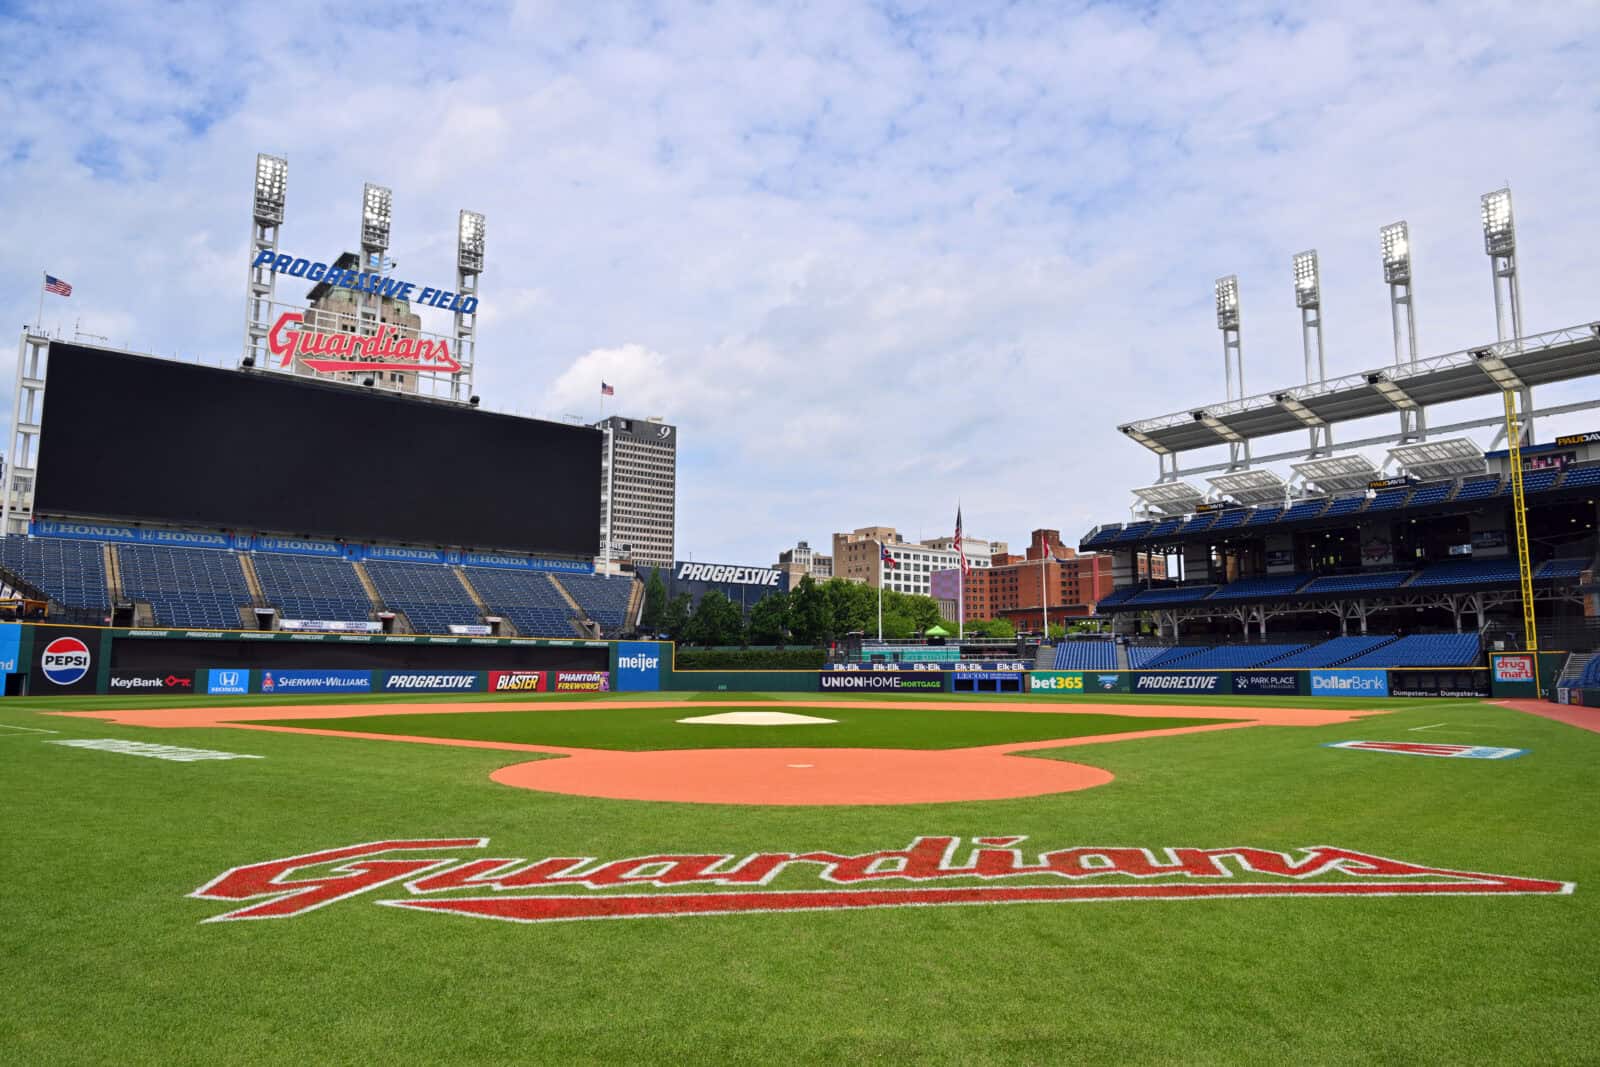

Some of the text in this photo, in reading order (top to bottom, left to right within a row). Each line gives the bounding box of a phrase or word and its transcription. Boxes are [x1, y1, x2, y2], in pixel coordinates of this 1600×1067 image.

[252, 250, 479, 315] PROGRESSIVE FIELD
[268, 312, 462, 373] Guardians
[59, 524, 135, 538] HONDA
[158, 531, 226, 545] HONDA
[276, 540, 338, 552] HONDA
[383, 548, 440, 560] HONDA
[480, 555, 529, 566] HONDA
[543, 560, 589, 570] HONDA
[677, 563, 782, 586] PROGRESSIVE
[45, 655, 87, 667] PEPSI
[618, 653, 659, 672] meijer
[1497, 657, 1526, 670] drug
[110, 677, 164, 689] KeyBank
[386, 675, 477, 688] PROGRESSIVE
[496, 675, 540, 690] BLASTER
[559, 673, 601, 682] PHANTOM
[1031, 676, 1084, 689] bet365
[1137, 676, 1217, 689] PROGRESSIVE
[1250, 676, 1295, 685] PARK PLACE
[558, 682, 600, 690] FIREWORKS
[188, 835, 1576, 924] Guardians
